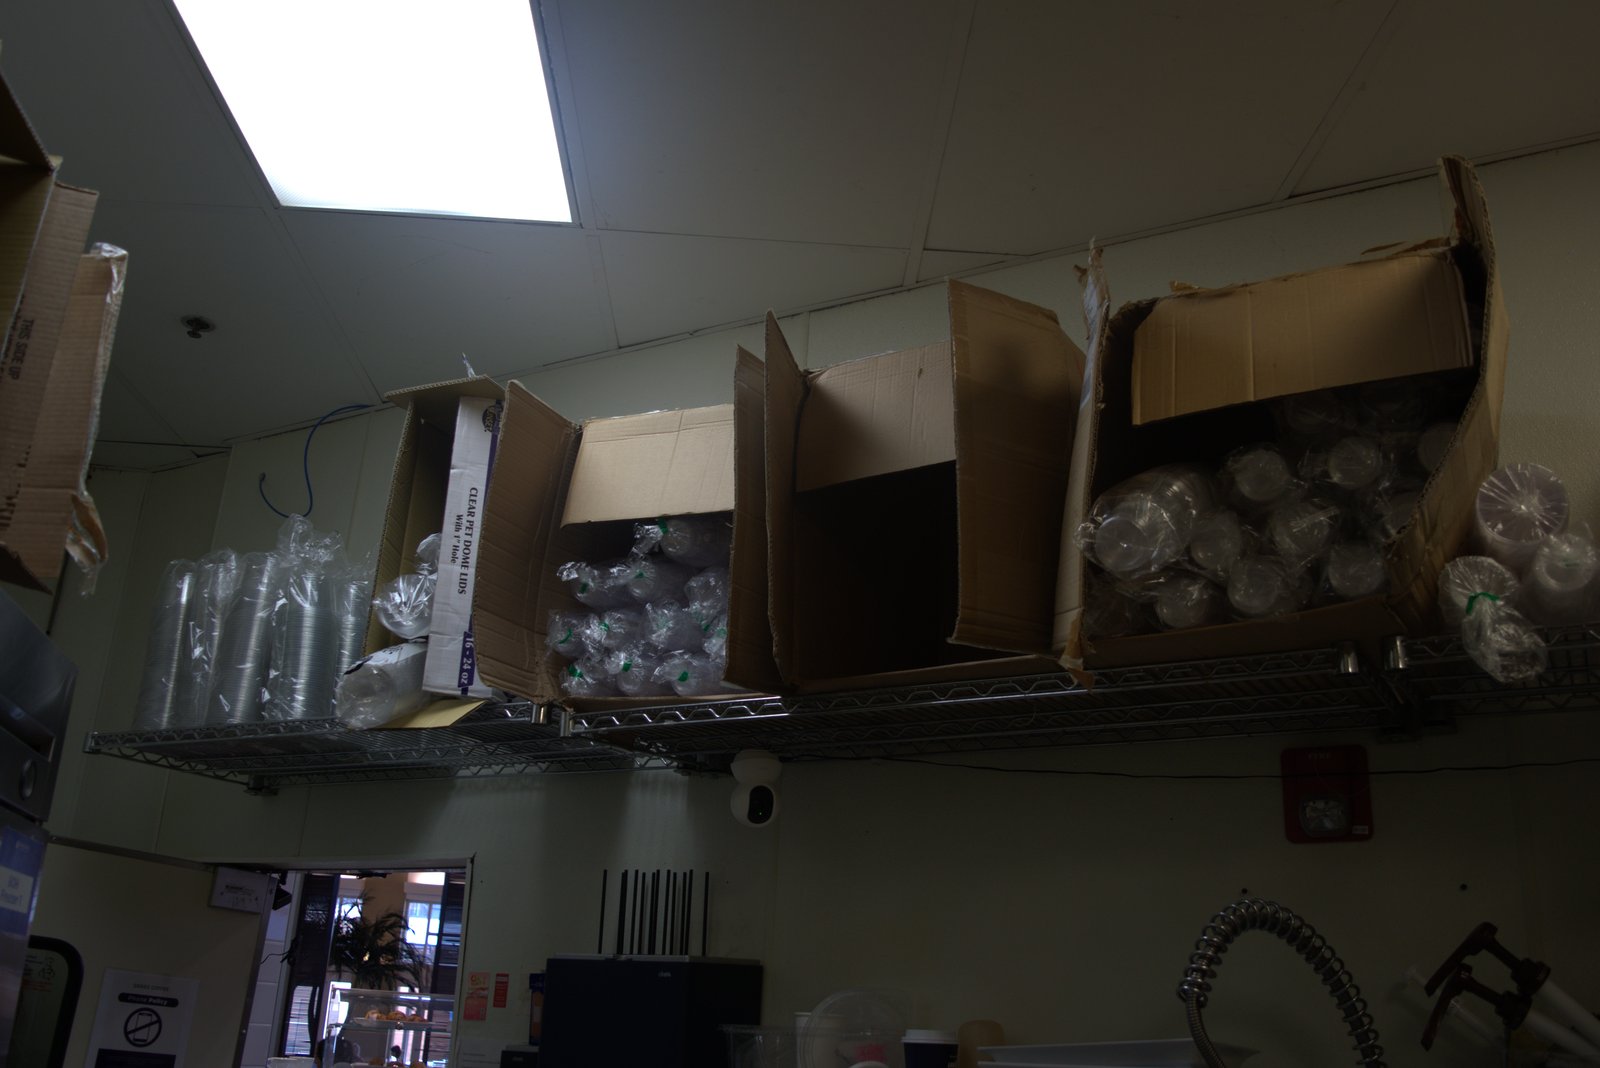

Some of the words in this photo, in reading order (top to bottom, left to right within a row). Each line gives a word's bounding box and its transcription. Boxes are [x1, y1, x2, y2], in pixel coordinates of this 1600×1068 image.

[18, 320, 34, 340] THIS
[12, 341, 27, 364] SIDE
[8, 367, 22, 380] UP
[467, 487, 478, 517] CLEAR
[454, 514, 463, 533] With
[464, 519, 474, 538] PET
[451, 545, 460, 564] Hole
[461, 540, 472, 571] DOME
[458, 572, 468, 595] LIDS
[465, 637, 474, 648] 16
[462, 657, 472, 669] 24
[460, 672, 469, 684] oz
